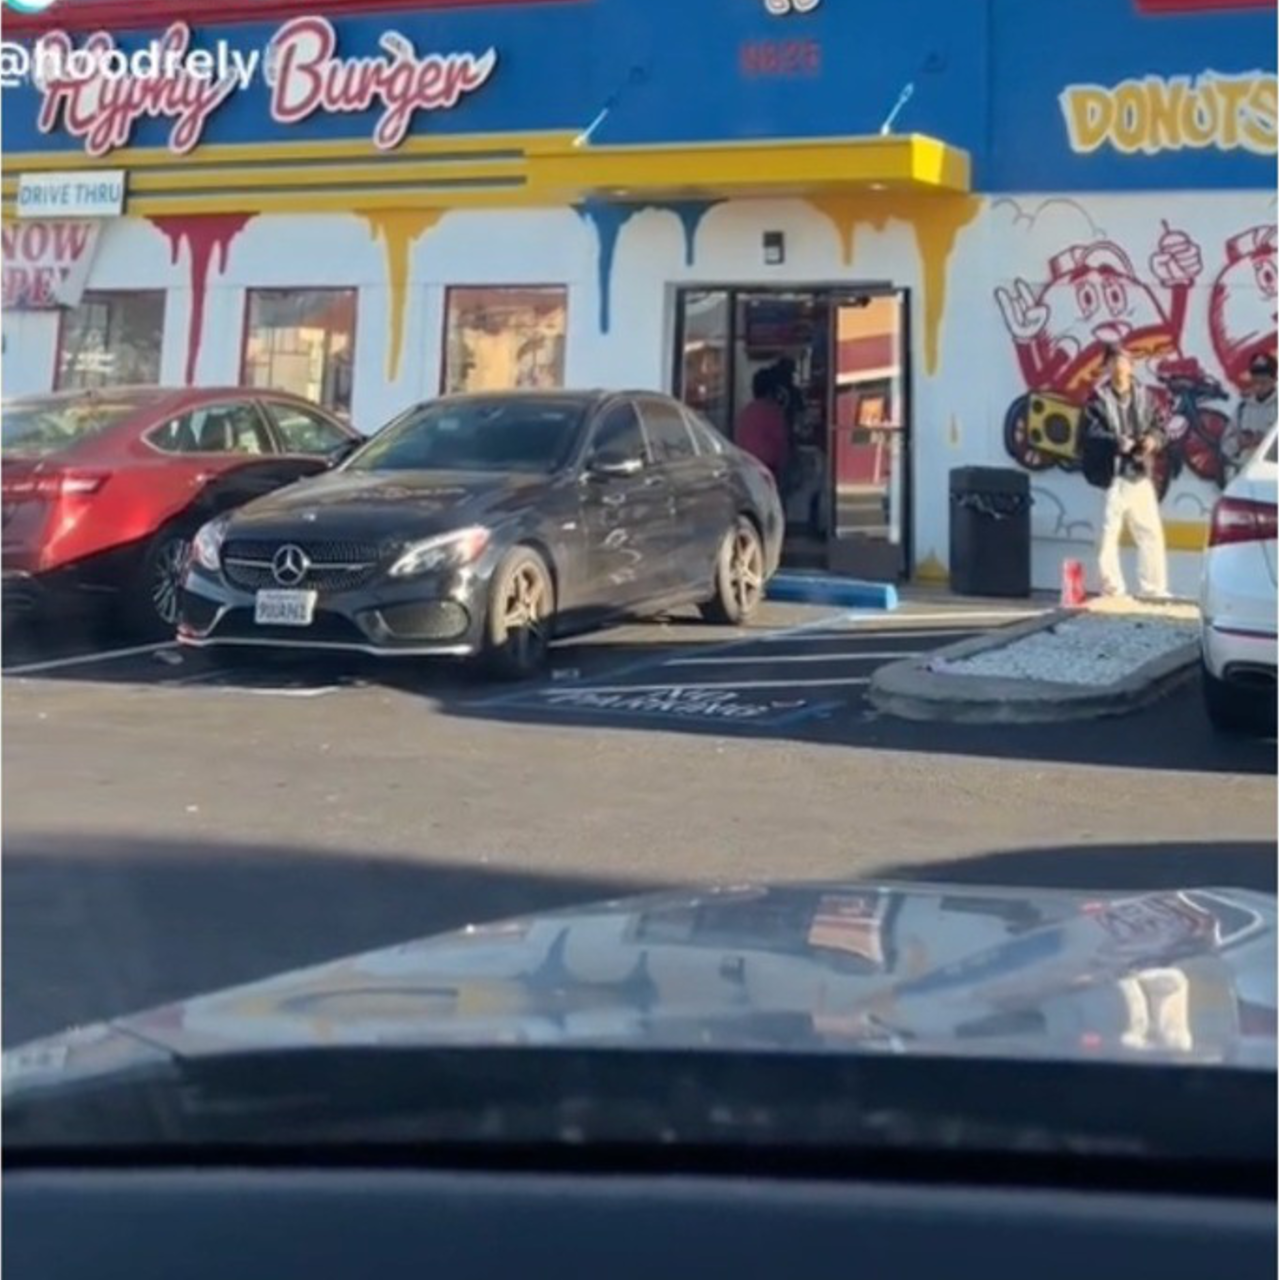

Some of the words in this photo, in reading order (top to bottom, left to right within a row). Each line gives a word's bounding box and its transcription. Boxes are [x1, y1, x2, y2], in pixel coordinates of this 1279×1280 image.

[269, 15, 496, 150] Burger
[1058, 69, 1278, 156] DONUTS
[19, 184, 70, 206] DRIVE
[75, 182, 121, 204] THRU
[1, 222, 91, 262] NOW
[1, 268, 68, 307] PE
